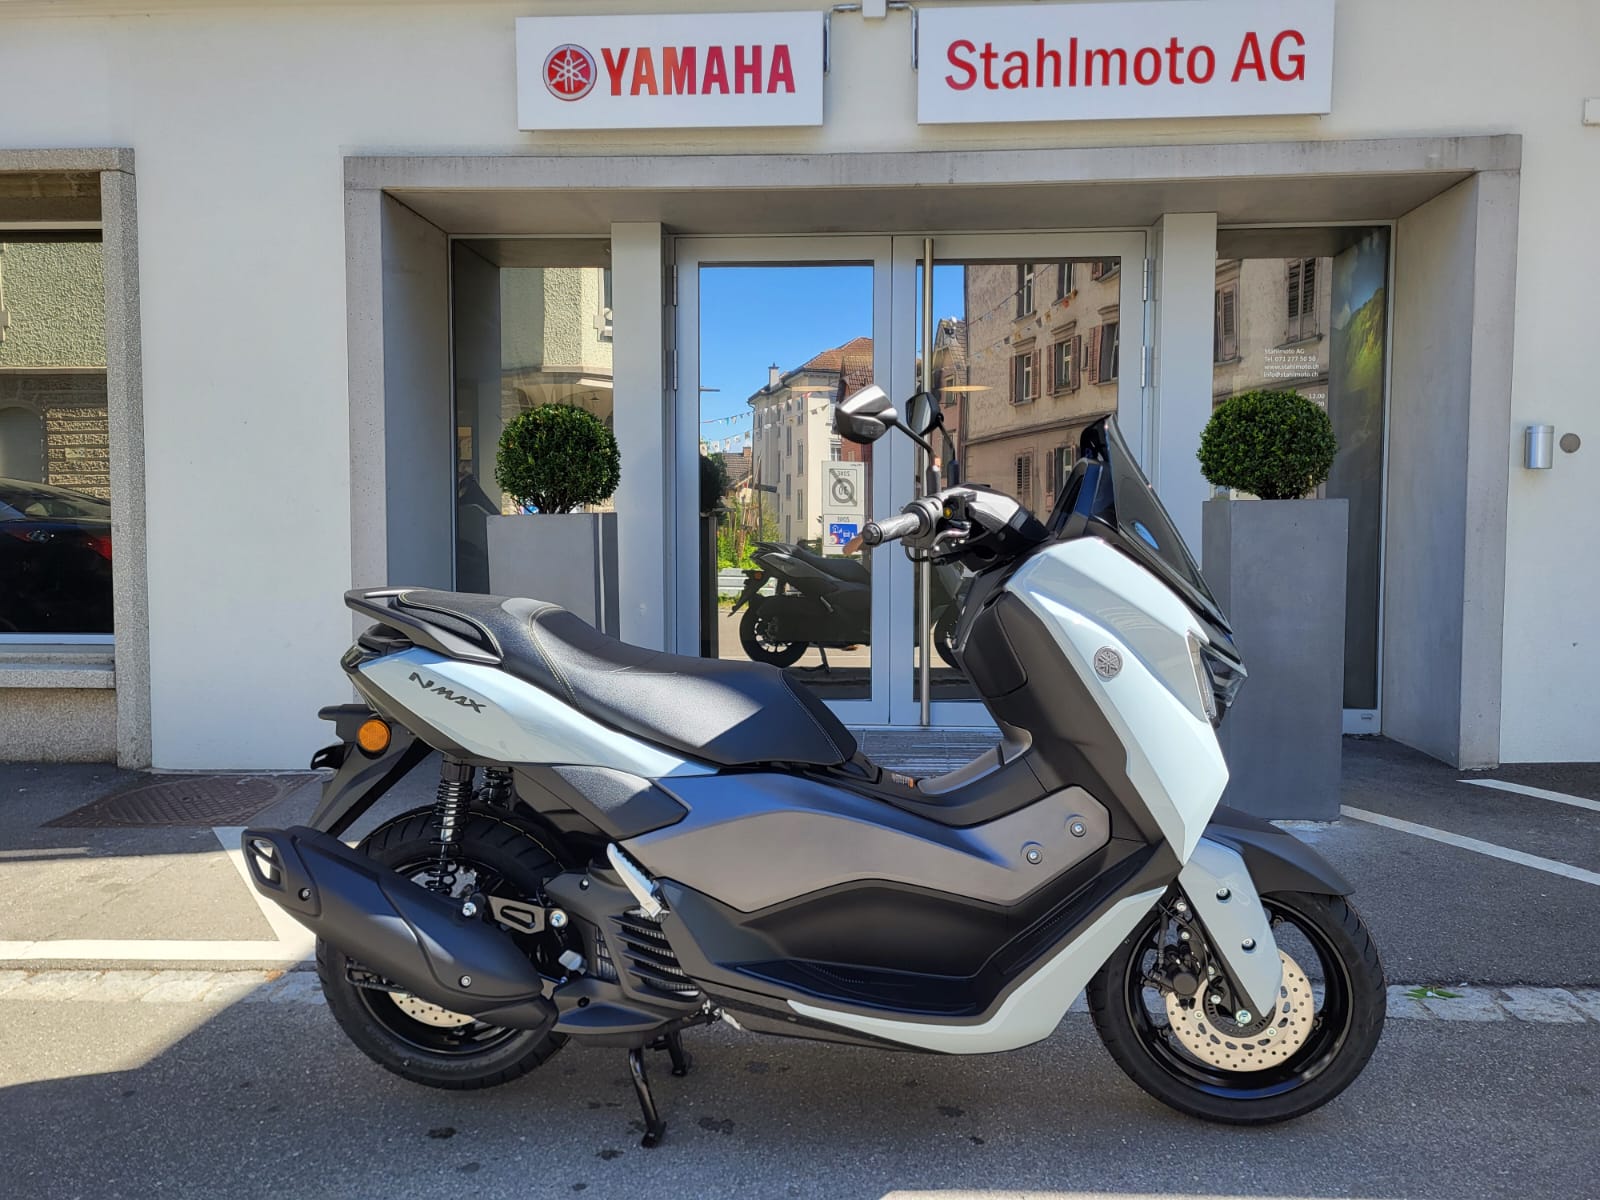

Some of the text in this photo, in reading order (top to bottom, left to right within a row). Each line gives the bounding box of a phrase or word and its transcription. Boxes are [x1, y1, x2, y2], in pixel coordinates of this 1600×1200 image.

[602, 45, 795, 95] YAMAHA
[946, 30, 1305, 91] Stahlmoto AG
[408, 672, 487, 714] NMAX
